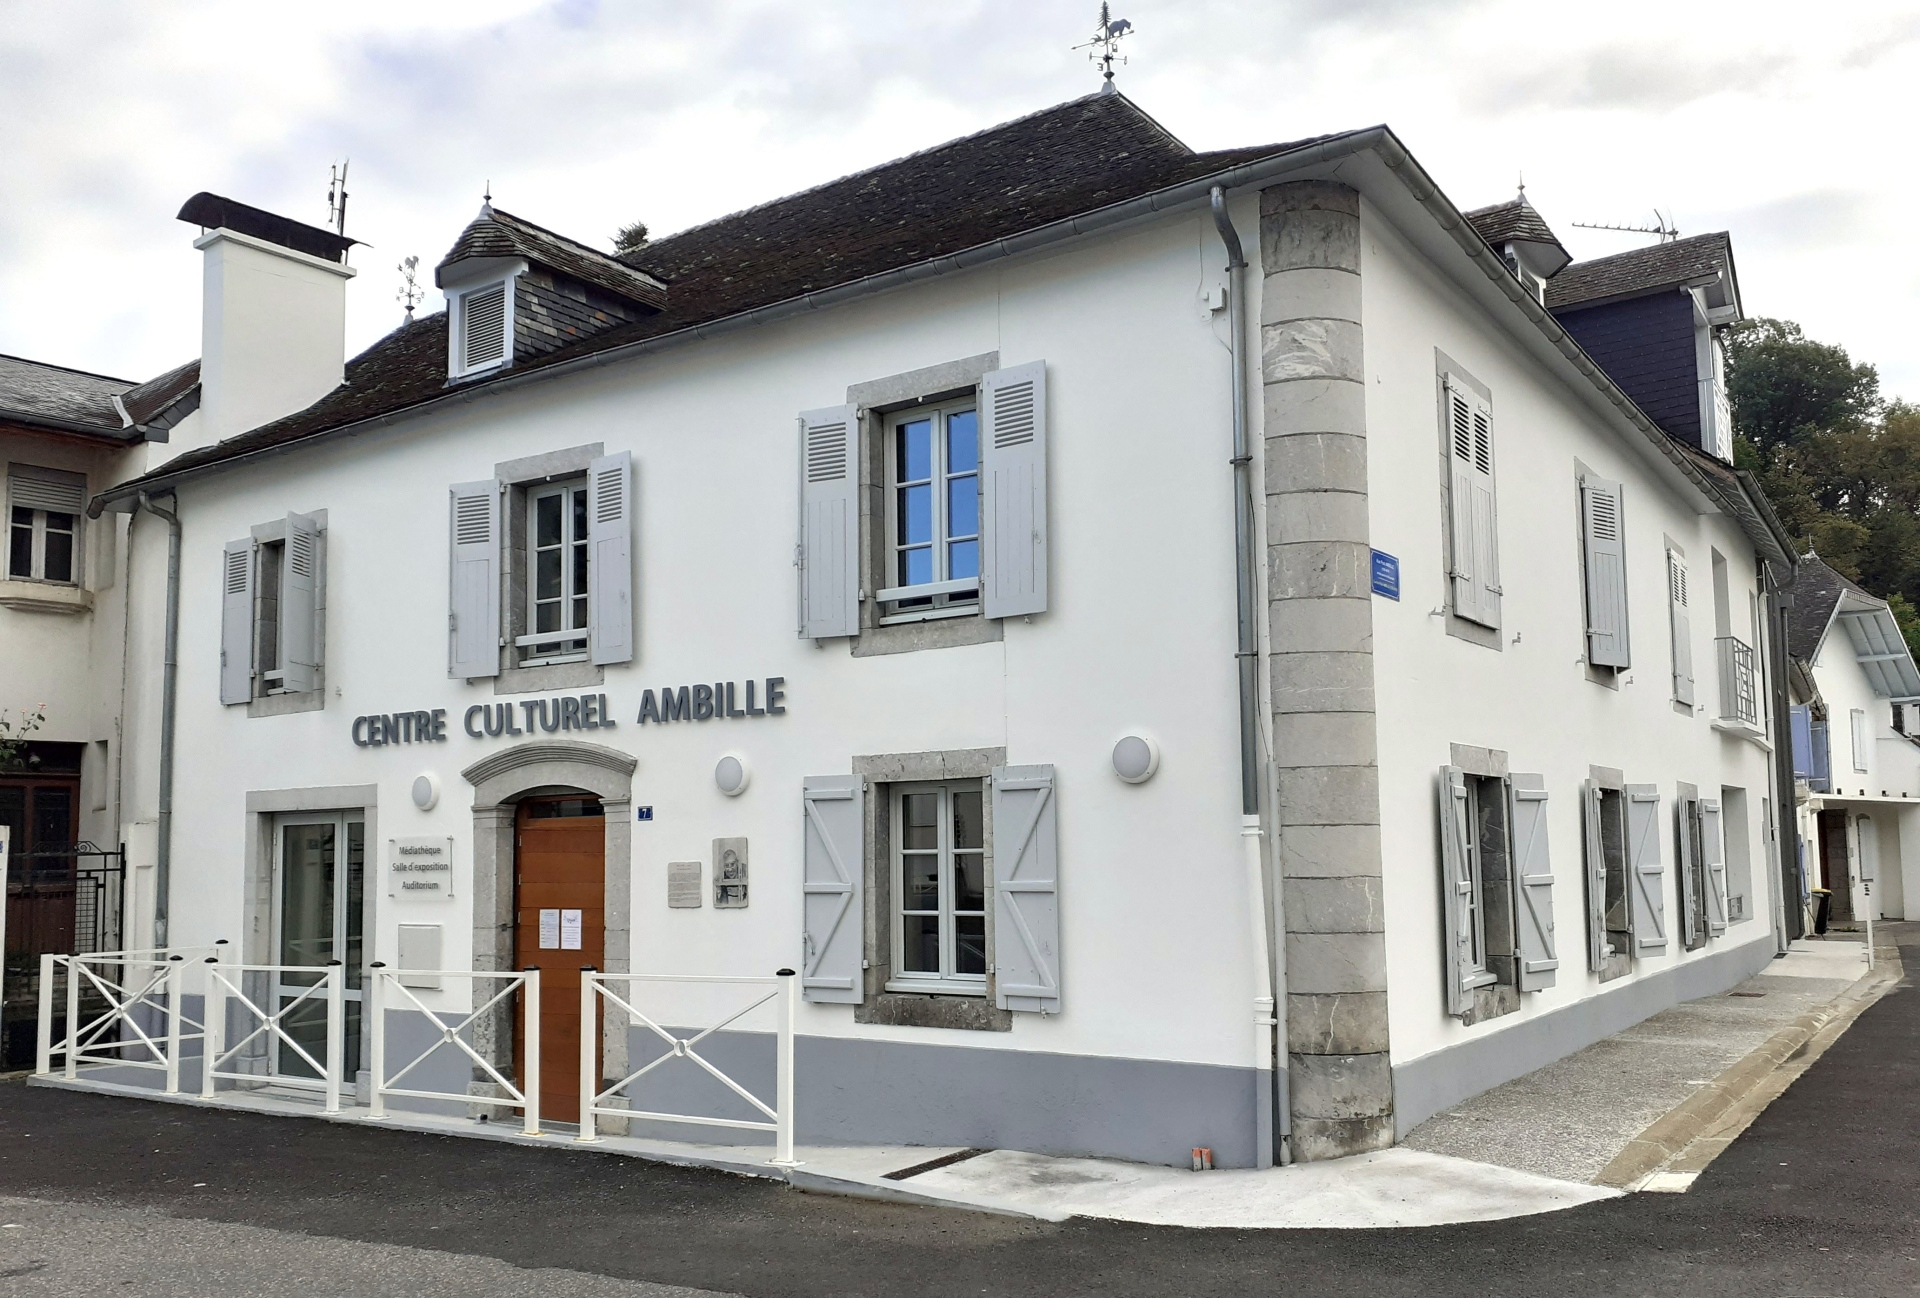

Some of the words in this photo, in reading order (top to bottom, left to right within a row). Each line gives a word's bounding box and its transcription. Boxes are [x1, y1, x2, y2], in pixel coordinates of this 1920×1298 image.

[352, 709, 446, 747] CENTRE
[464, 694, 616, 738] CULTUREL
[637, 677, 787, 725] AMBILLE
[399, 845, 441, 856] Médiathèque
[392, 862, 407, 872] Salle
[402, 881, 439, 890] Auditorium
